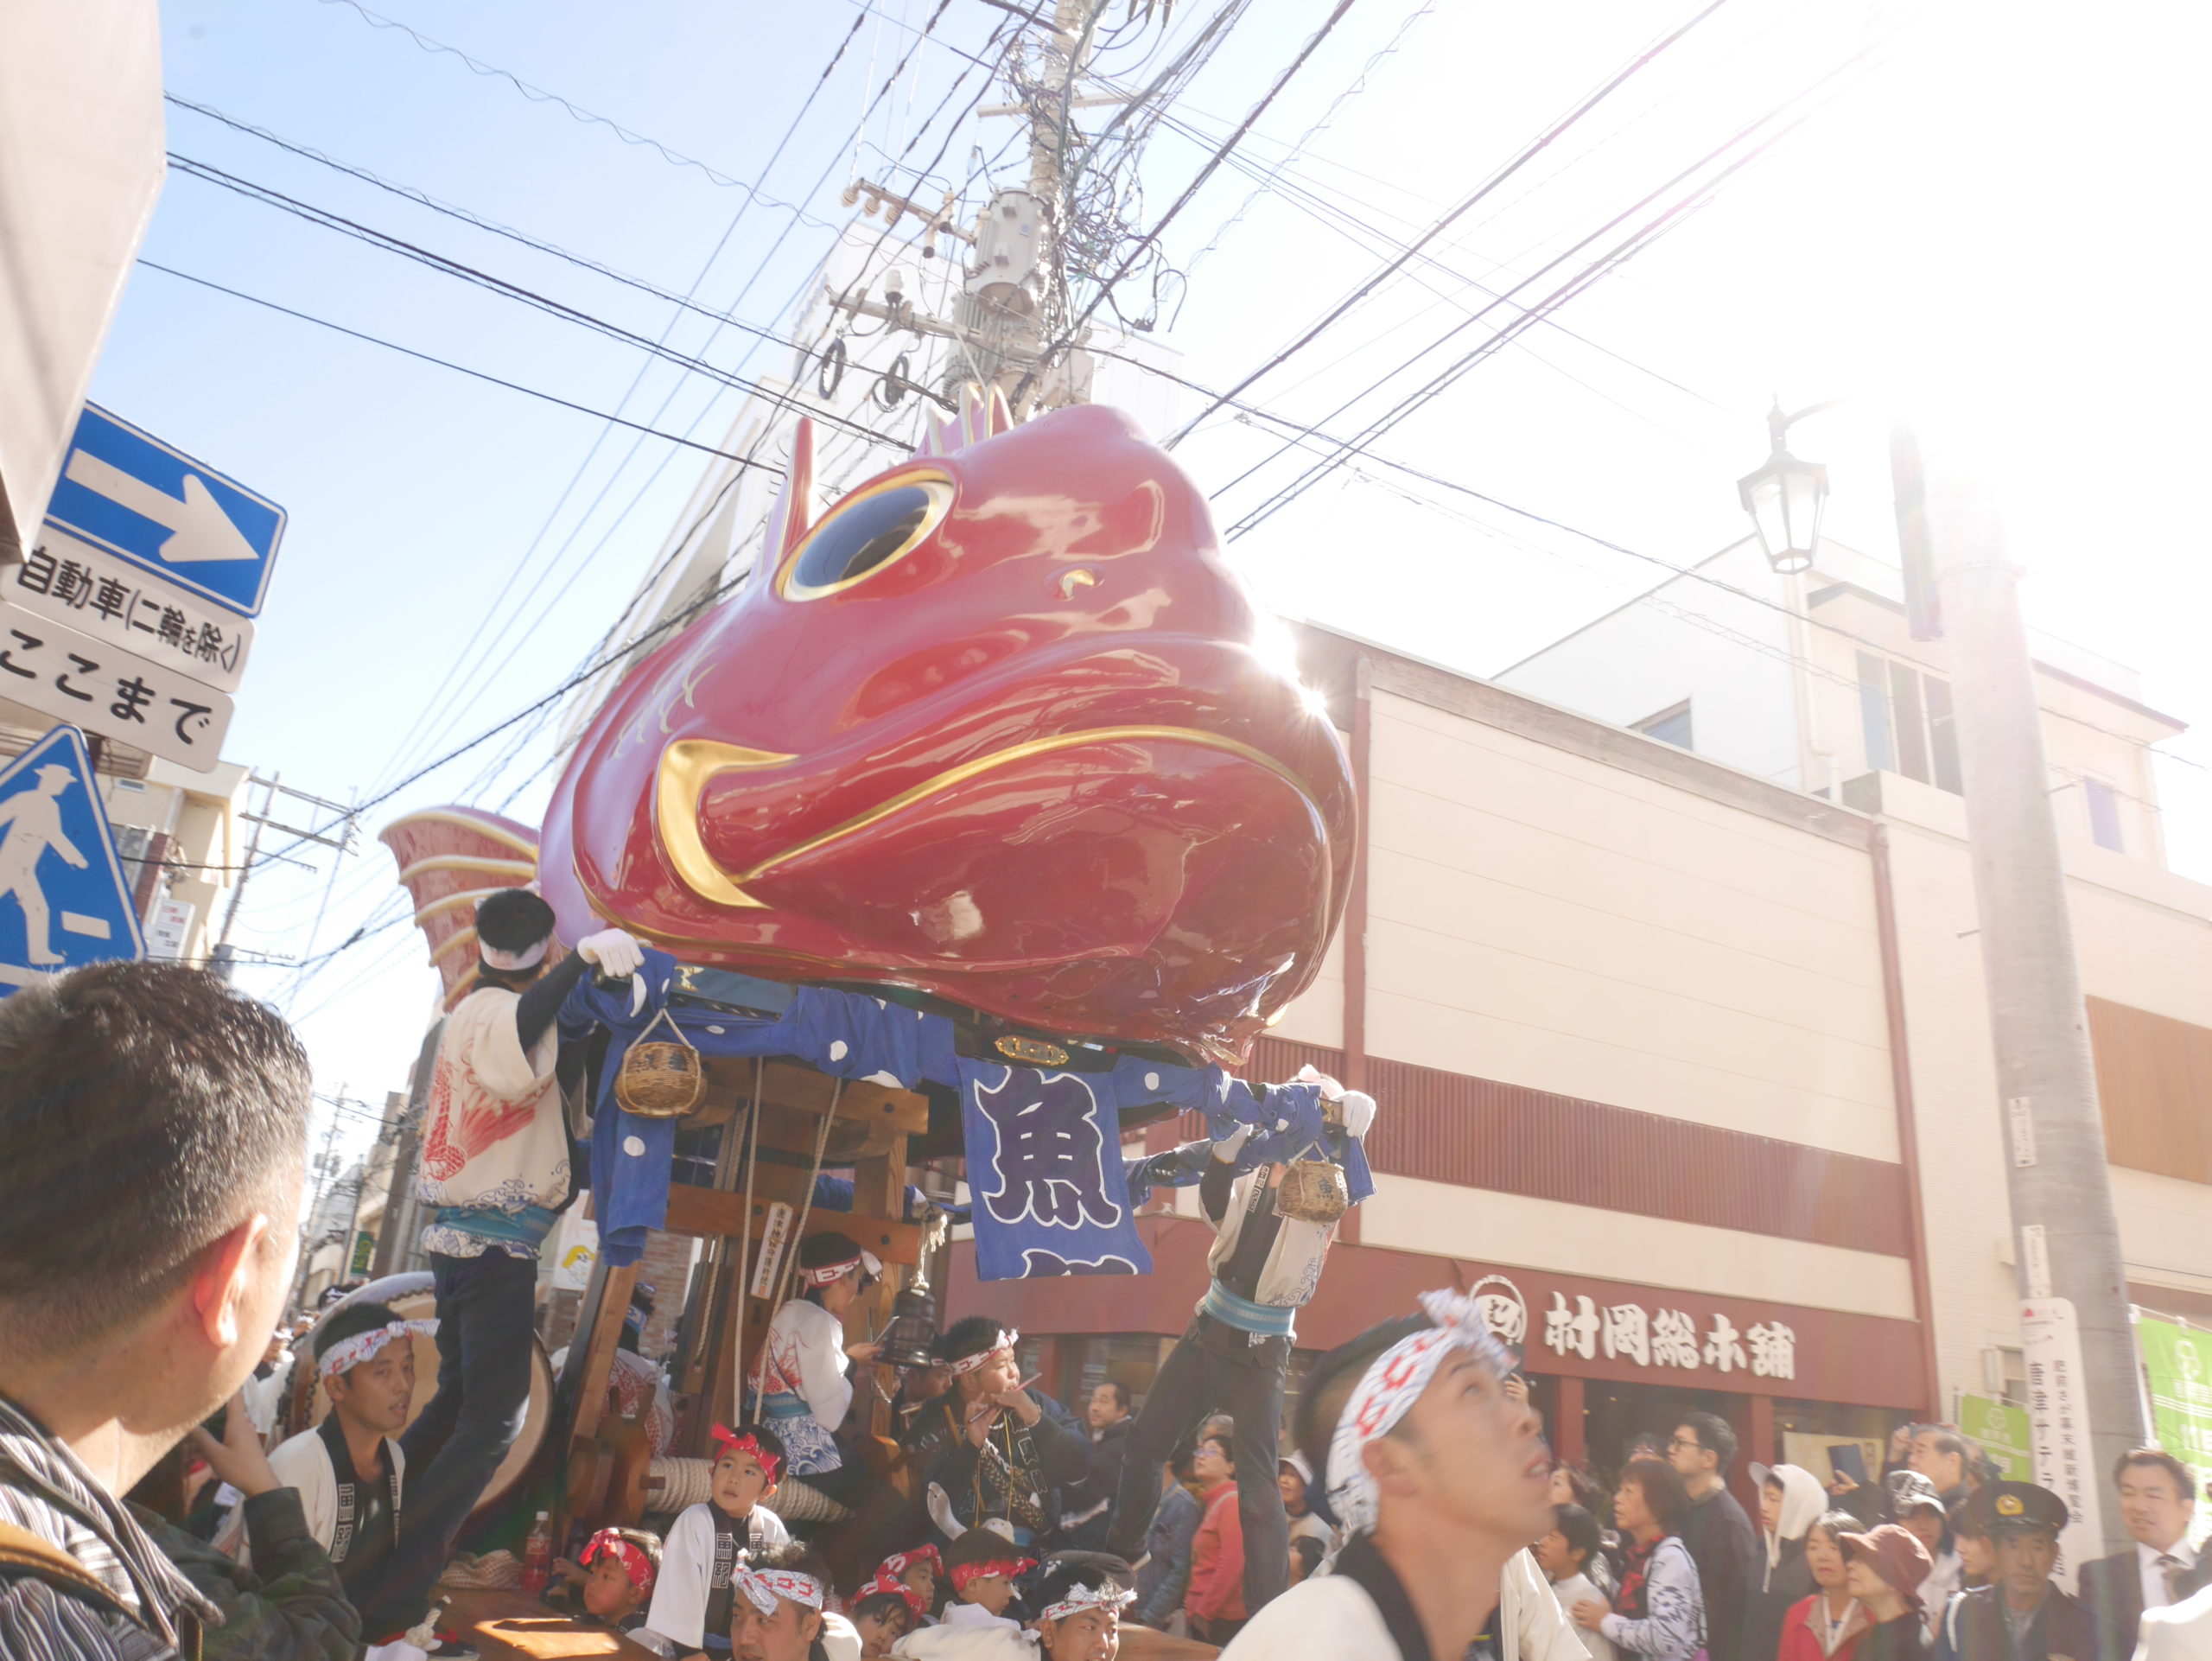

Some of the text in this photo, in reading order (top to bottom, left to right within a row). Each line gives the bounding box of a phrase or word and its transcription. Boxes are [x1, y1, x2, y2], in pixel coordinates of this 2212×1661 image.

[17, 547, 242, 673] 自動車(二輪を除く)
[0, 629, 212, 745] ここまで
[974, 1066, 1138, 1281] 魚
[1543, 1291, 1796, 1380] 村岡総本舗
